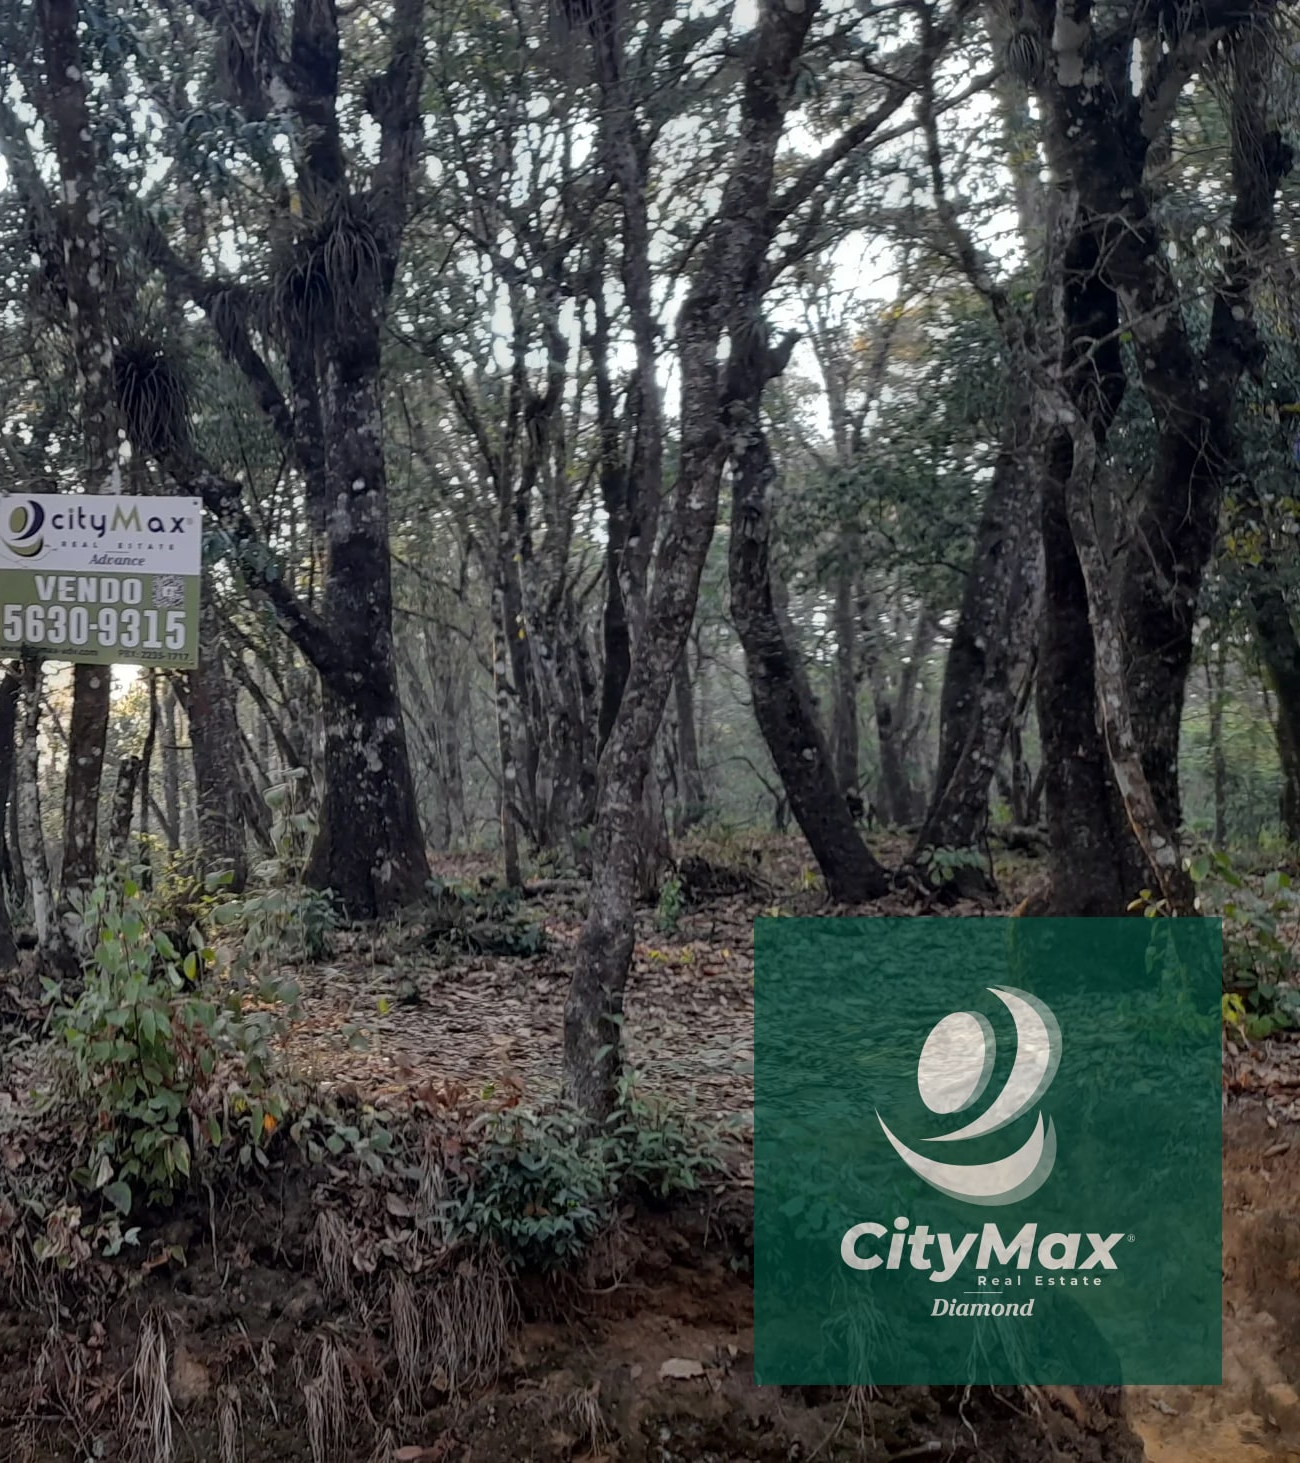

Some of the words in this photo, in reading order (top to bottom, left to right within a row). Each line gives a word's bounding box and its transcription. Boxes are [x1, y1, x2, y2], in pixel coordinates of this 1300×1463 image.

[51, 503, 185, 538] cityMax
[61, 541, 99, 549] REAL
[118, 542, 175, 551] ESTATE
[89, 554, 146, 567] Advance
[34, 575, 143, 605] VENDO
[3, 604, 187, 650] 5630-9315
